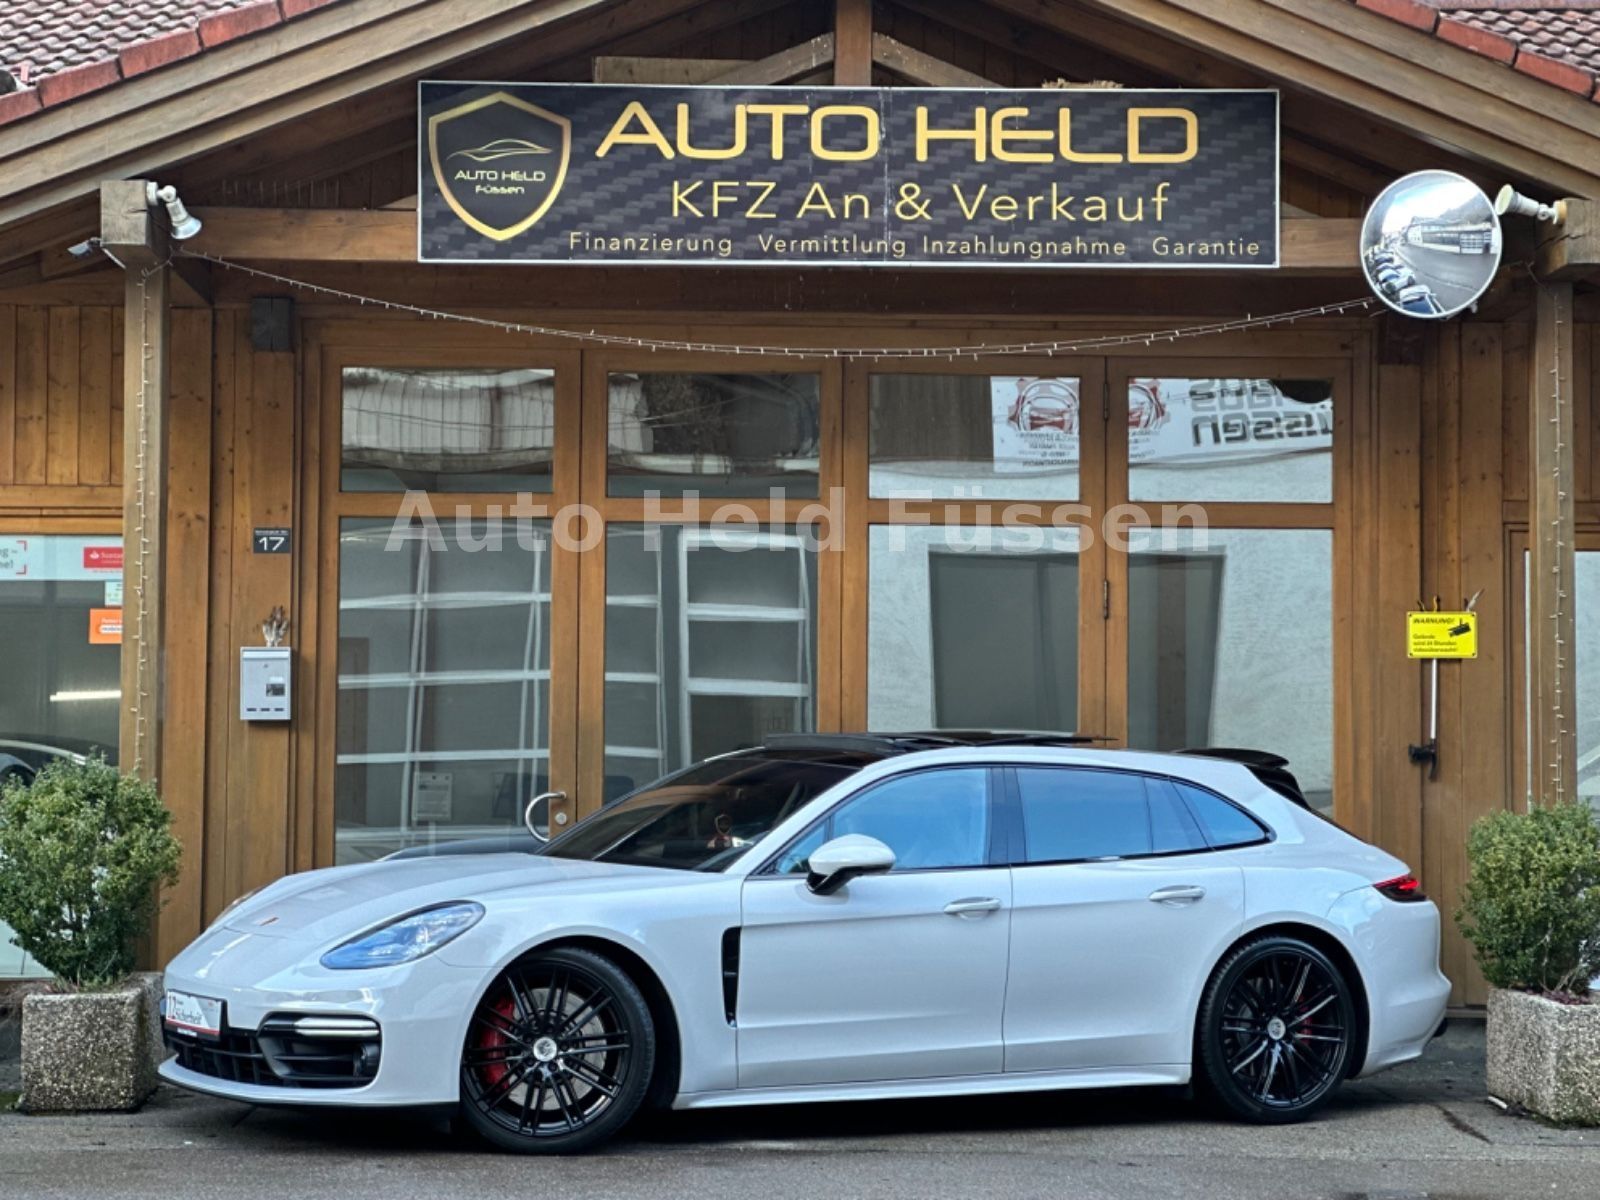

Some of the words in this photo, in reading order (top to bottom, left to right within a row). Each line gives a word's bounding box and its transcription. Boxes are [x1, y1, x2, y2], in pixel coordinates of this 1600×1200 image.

[595, 101, 880, 161] AUTO
[915, 105, 1199, 164] HELD
[454, 170, 498, 181] AUTO
[502, 170, 546, 182] HELD
[474, 183, 525, 195] Füssen
[672, 180, 777, 218] KFZ
[796, 182, 870, 219] An
[894, 181, 932, 221] &
[952, 181, 1170, 222] Verkauf
[568, 230, 732, 257] Finanzierung
[758, 233, 906, 258] Vermittlung
[922, 235, 1127, 259] Inzahlungnahme
[1151, 236, 1261, 257] Garantie
[258, 536, 285, 551] 17
